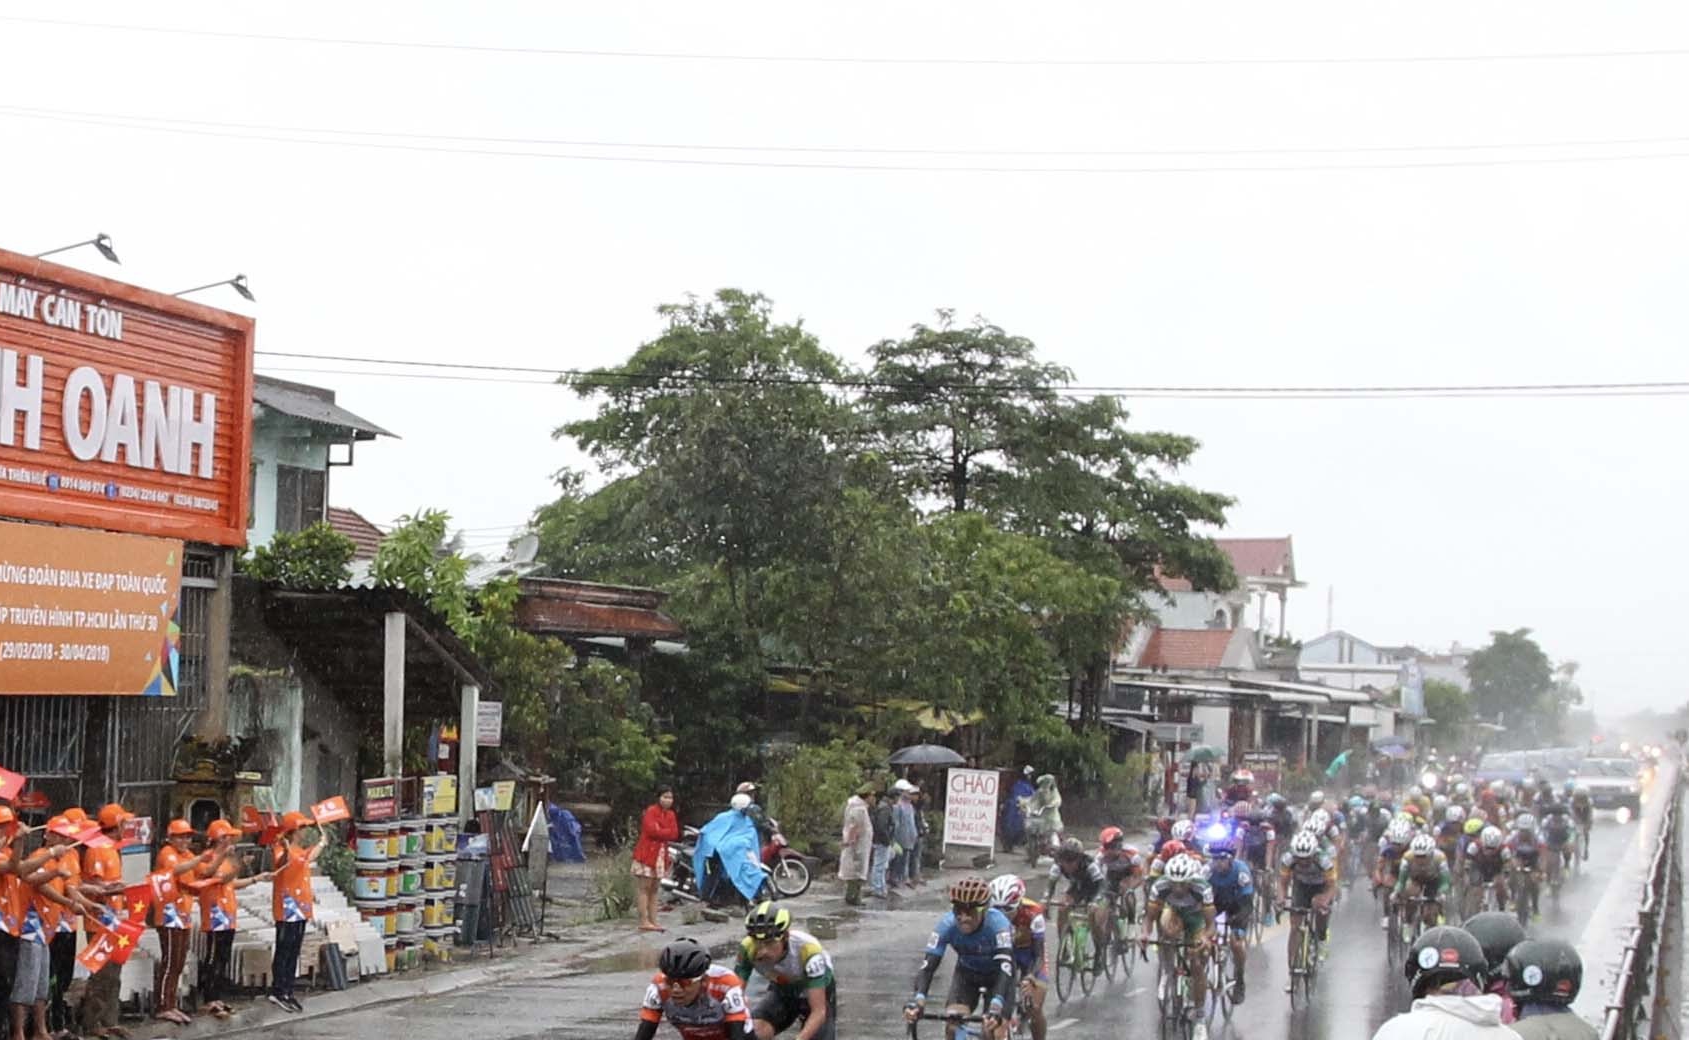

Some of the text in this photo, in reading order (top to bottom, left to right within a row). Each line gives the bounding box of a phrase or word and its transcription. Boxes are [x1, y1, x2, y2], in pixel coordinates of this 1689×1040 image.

[40, 288, 82, 331] CÁN
[85, 299, 123, 341] TÔN
[62, 366, 217, 479] OANH
[28, 563, 58, 587] ĐOÀN
[82, 572, 94, 589] XE
[115, 571, 141, 593] TOÀN
[142, 572, 168, 596] QUỐC
[10, 604, 46, 626] TRUYỀN
[48, 605, 75, 628] HÌNH
[75, 611, 108, 630] TP.HCM
[147, 615, 158, 632] 30
